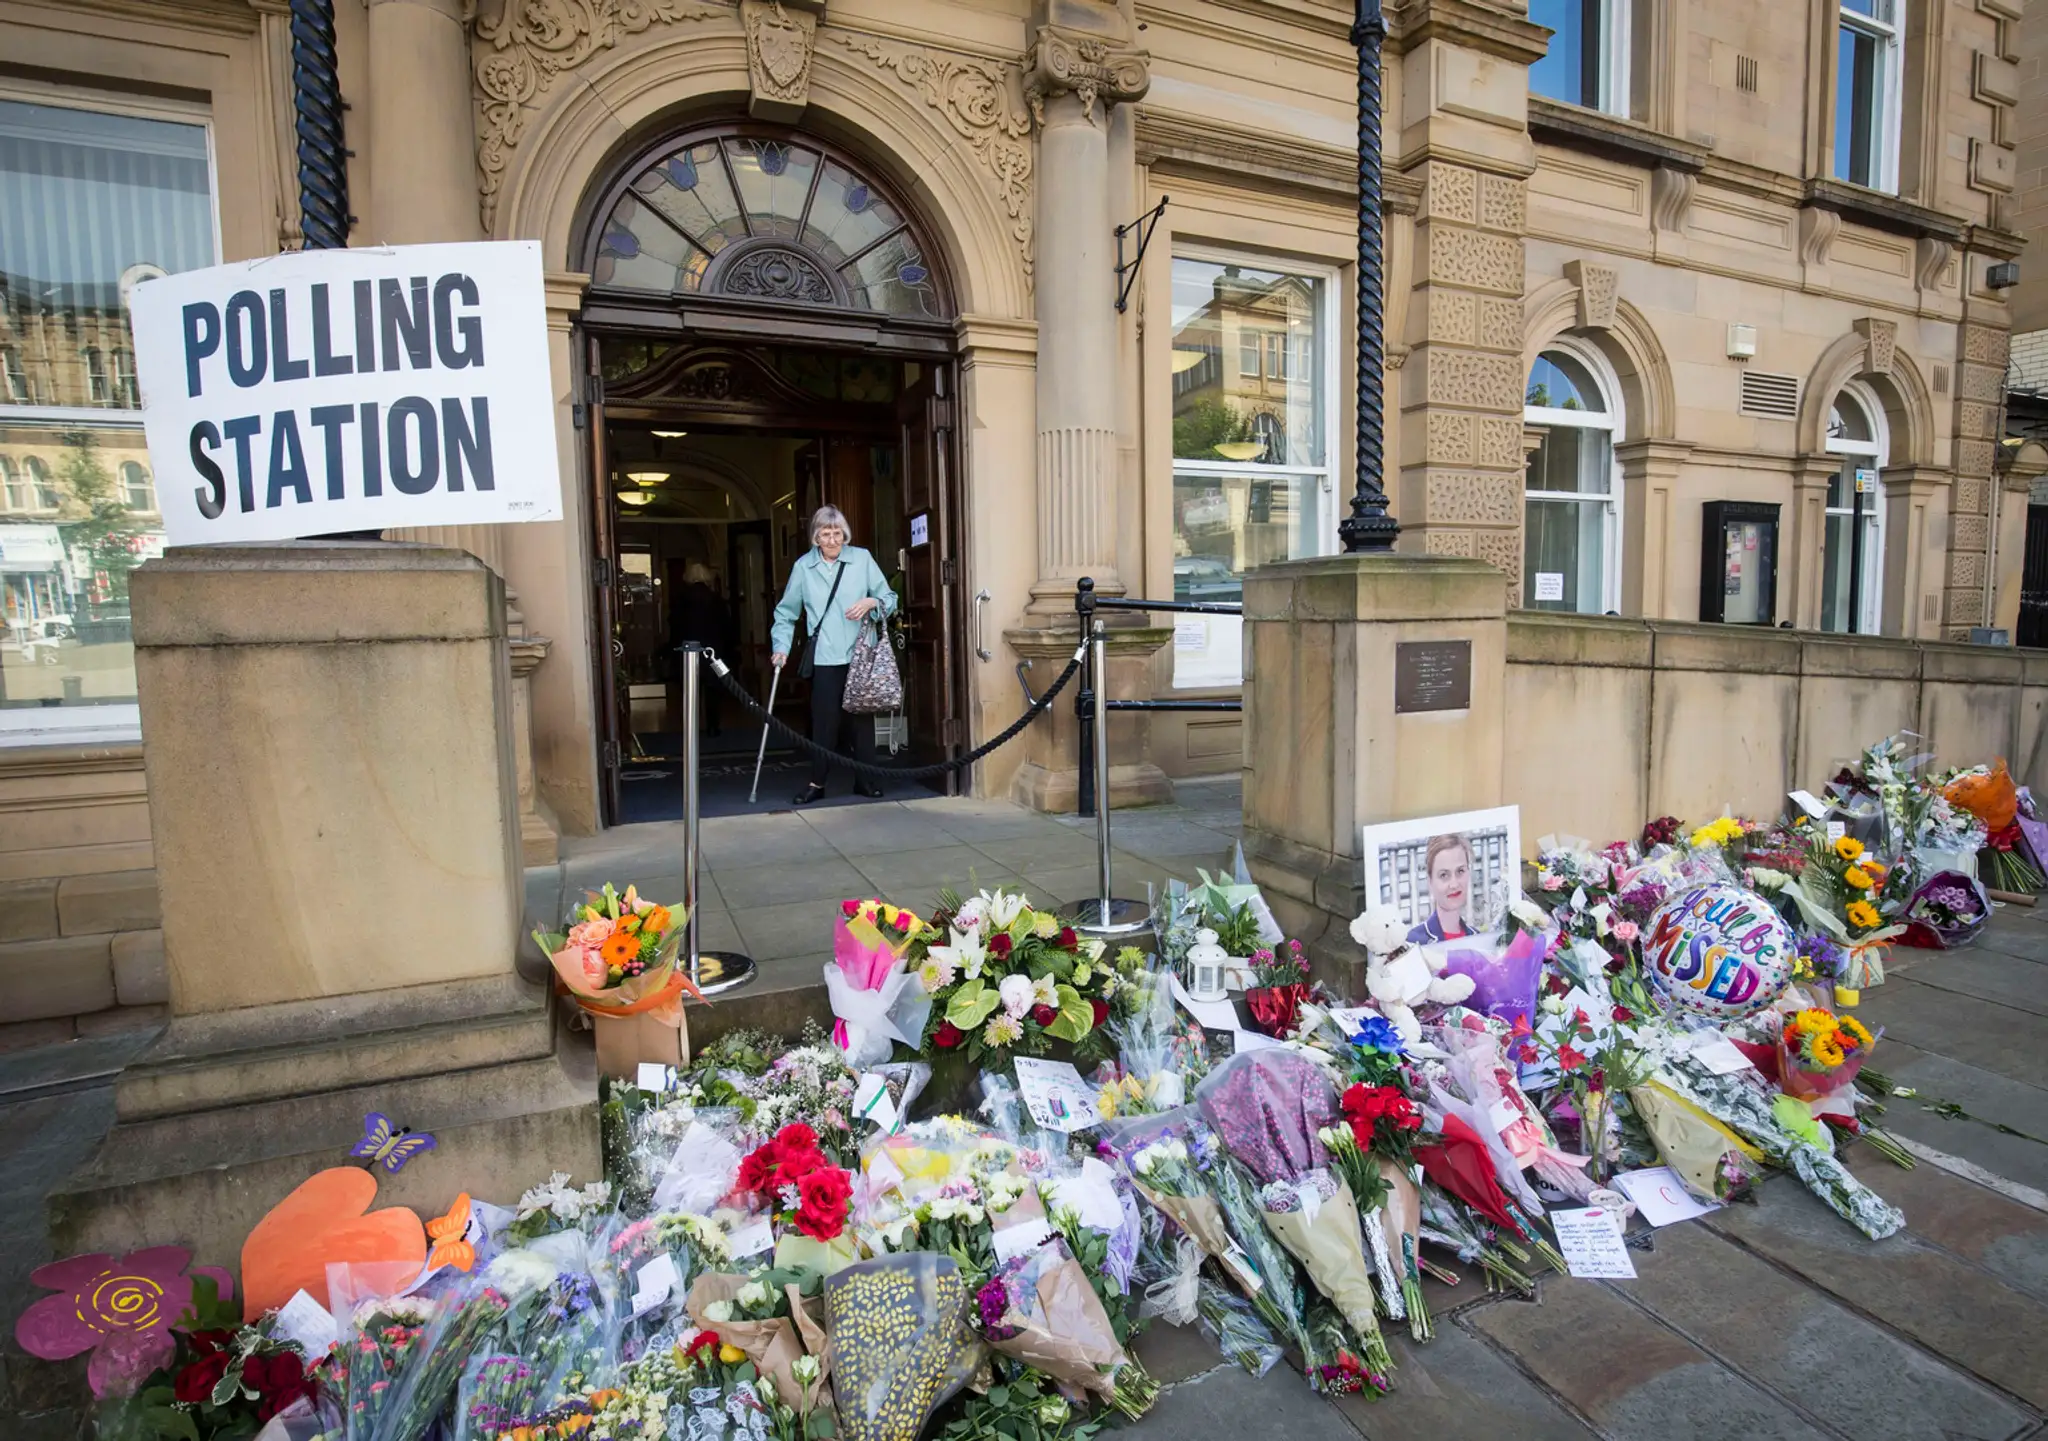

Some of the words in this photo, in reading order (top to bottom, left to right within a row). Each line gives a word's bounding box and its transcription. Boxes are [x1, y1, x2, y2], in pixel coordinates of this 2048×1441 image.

[182, 272, 486, 398] POLLING
[188, 396, 496, 520] STATION
[1740, 923, 1777, 966] be
